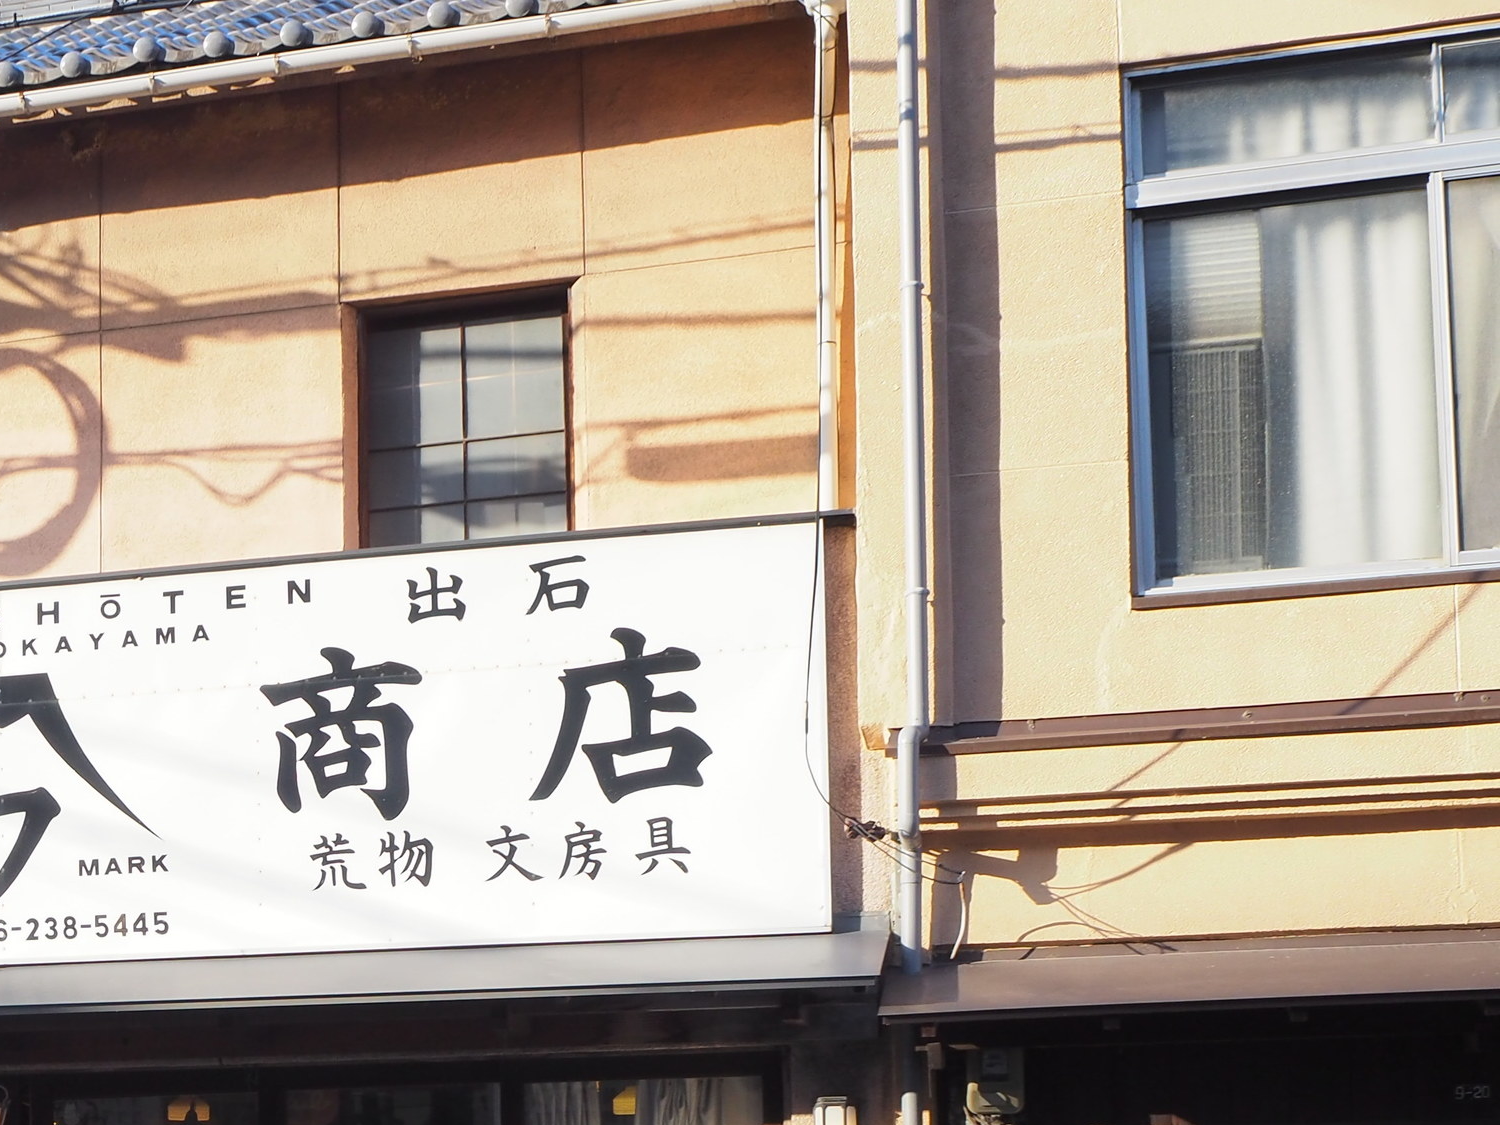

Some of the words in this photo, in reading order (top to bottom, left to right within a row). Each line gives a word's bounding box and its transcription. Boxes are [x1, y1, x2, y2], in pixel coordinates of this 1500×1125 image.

[406, 555, 590, 624] 出石
[259, 628, 713, 821] 商店
[78, 854, 169, 876] MARK
[310, 830, 434, 890] 荒物
[485, 816, 691, 882] 文房具
[1455, 1086, 1490, 1100] 9-20
